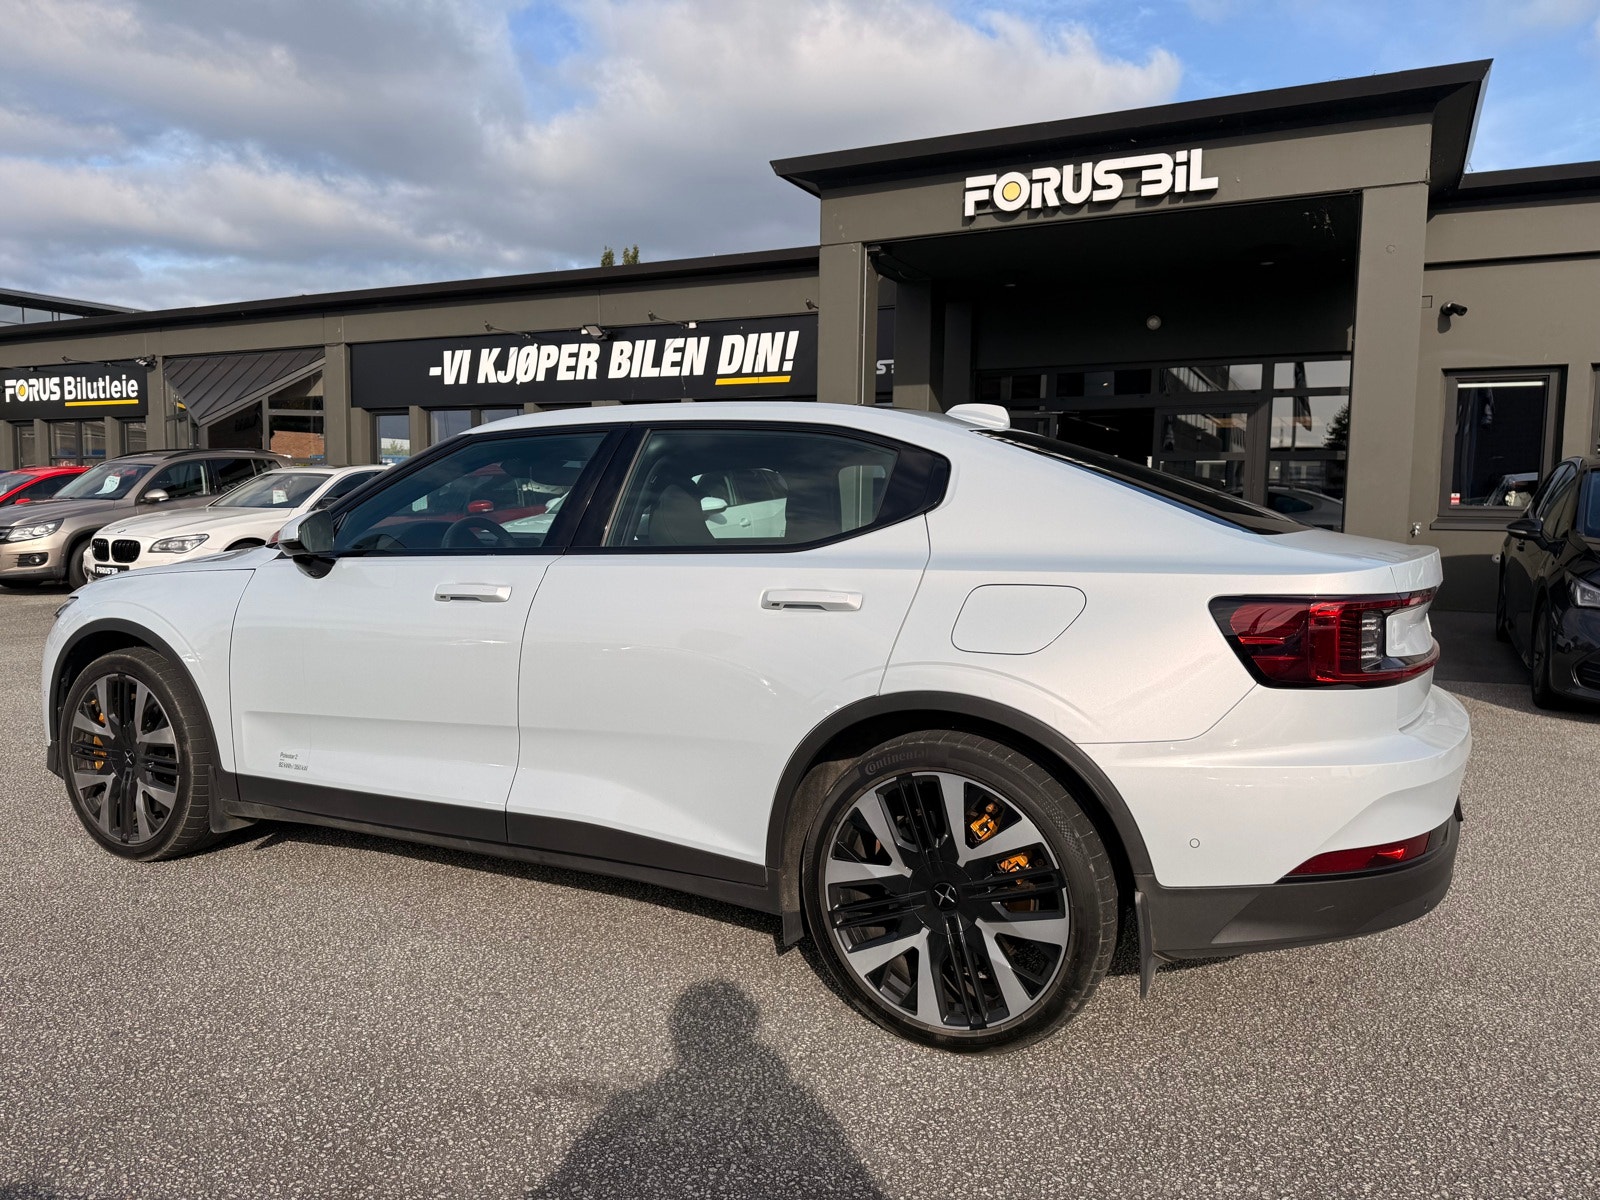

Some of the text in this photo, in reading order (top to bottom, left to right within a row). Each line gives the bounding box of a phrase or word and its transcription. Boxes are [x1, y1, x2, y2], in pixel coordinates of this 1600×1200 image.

[964, 159, 1124, 217] FORUS
[477, 342, 599, 386] KJØPER
[607, 336, 710, 380] BILEN
[716, 330, 800, 375] DIN!
[4, 374, 139, 403] FORUS Bilutleie
[864, 748, 929, 775] Continental
